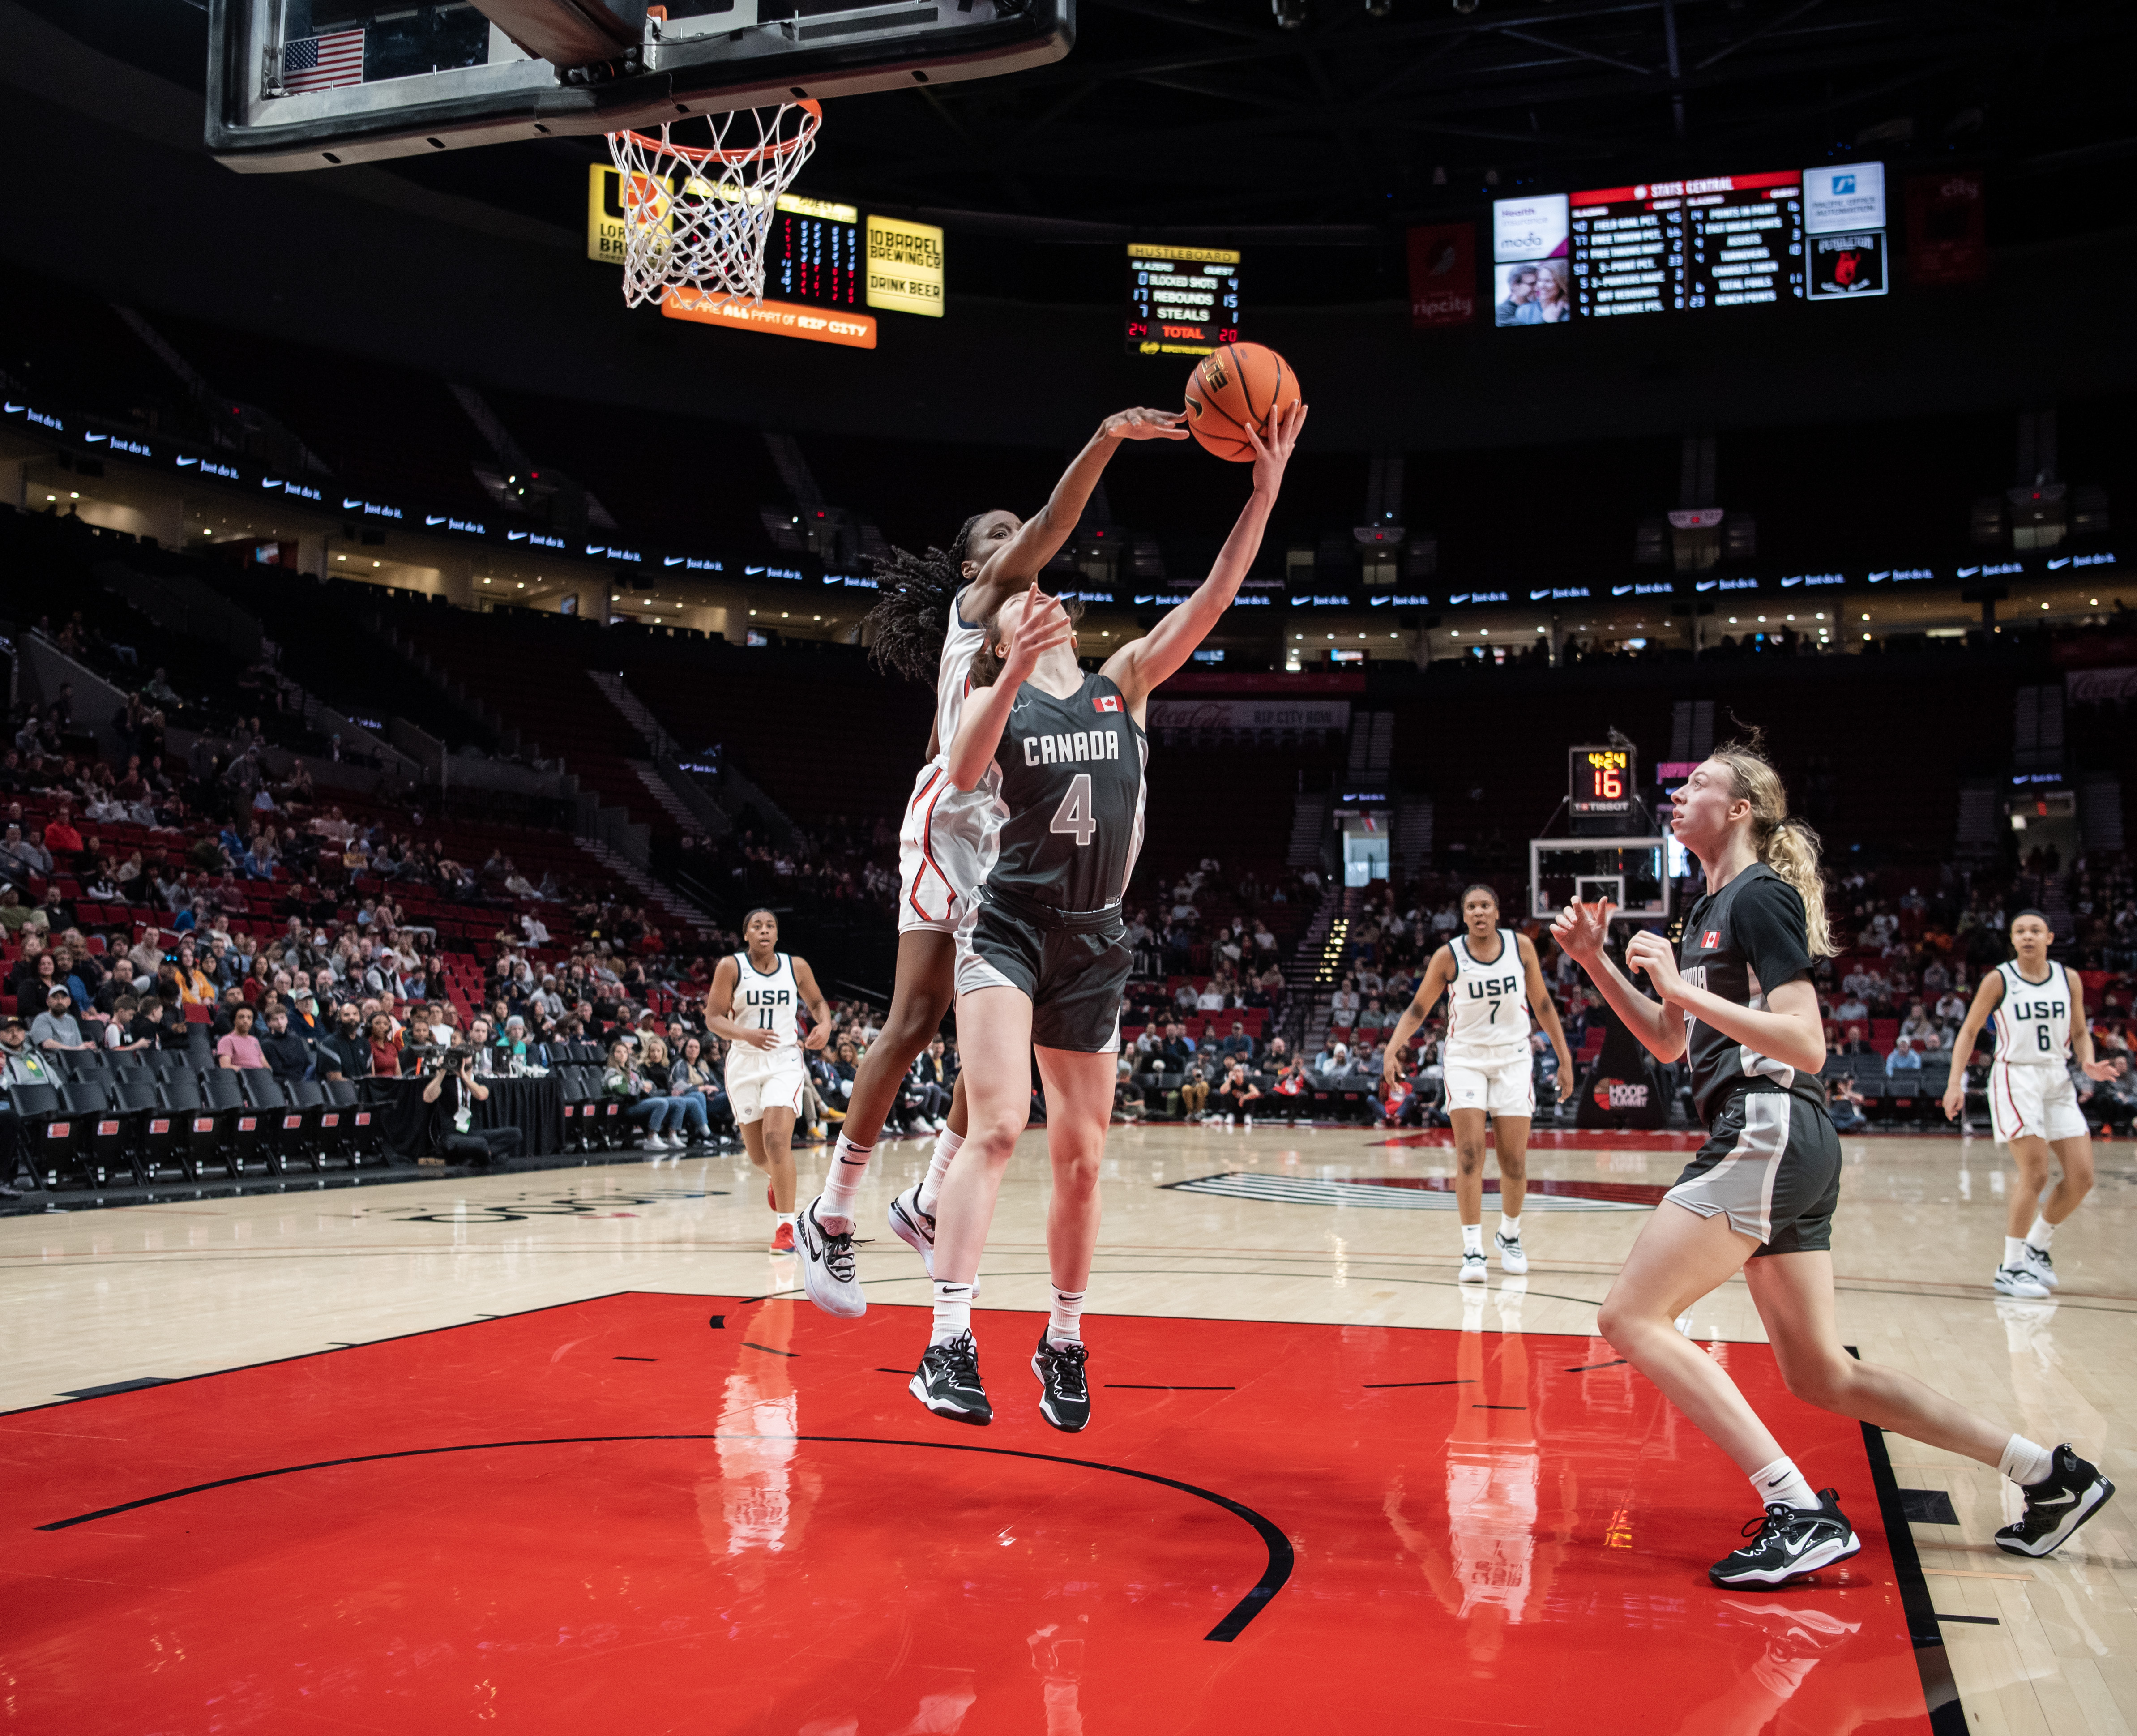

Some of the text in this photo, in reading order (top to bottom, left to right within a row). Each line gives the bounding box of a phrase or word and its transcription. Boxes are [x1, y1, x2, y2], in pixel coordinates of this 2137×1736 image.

[1651, 176, 1734, 198] STATS CENTRAL
[885, 232, 940, 256] BARREL
[1727, 233, 1762, 247] ASSISTS
[870, 245, 923, 266] BREWING
[1135, 247, 1231, 262] HUSTLEBOARD
[871, 276, 940, 299] DRINK BEER
[1149, 274, 1188, 287] BLOCKED
[1189, 275, 1218, 290] SHOTS
[1228, 278, 1239, 291] 4
[1133, 288, 1238, 308] 17 REBOUNDS 15
[723, 305, 749, 320] ALL
[751, 309, 782, 324] PART
[782, 314, 797, 325] OF
[798, 316, 827, 331] RIP
[828, 321, 868, 337] CITY
[1139, 304, 1238, 324] 7 STEALS 1
[1128, 323, 1238, 342] 24 TOTAL 20
[27, 408, 43, 423] Just
[43, 415, 55, 427] do
[110, 436, 128, 451] Just
[128, 441, 142, 453] do
[200, 459, 217, 474] Just
[218, 464, 230, 476] do
[364, 502, 381, 515] Just
[381, 505, 394, 517] do
[448, 517, 465, 530] Just
[464, 521, 477, 532] do
[530, 533, 546, 545] Just
[545, 536, 557, 547] do
[607, 547, 622, 559] Just
[622, 550, 633, 560] do
[686, 557, 703, 569] Just
[702, 560, 714, 570] do
[844, 575, 860, 586] Just
[859, 577, 871, 588] do
[1023, 731, 1119, 766] CANADA
[1589, 751, 1626, 770] 4:24
[1594, 768, 1622, 798] 16
[1050, 774, 1096, 846] 4
[1590, 801, 1629, 811] TISSOT
[1468, 975, 1517, 999] USA
[746, 990, 790, 1006] USA
[759, 1008, 774, 1030] 11
[1489, 1001, 1501, 1024] 7
[2014, 1001, 2064, 1021] USA
[2037, 1025, 2050, 1051] 6
[1609, 1083, 1649, 1097] HOOP
